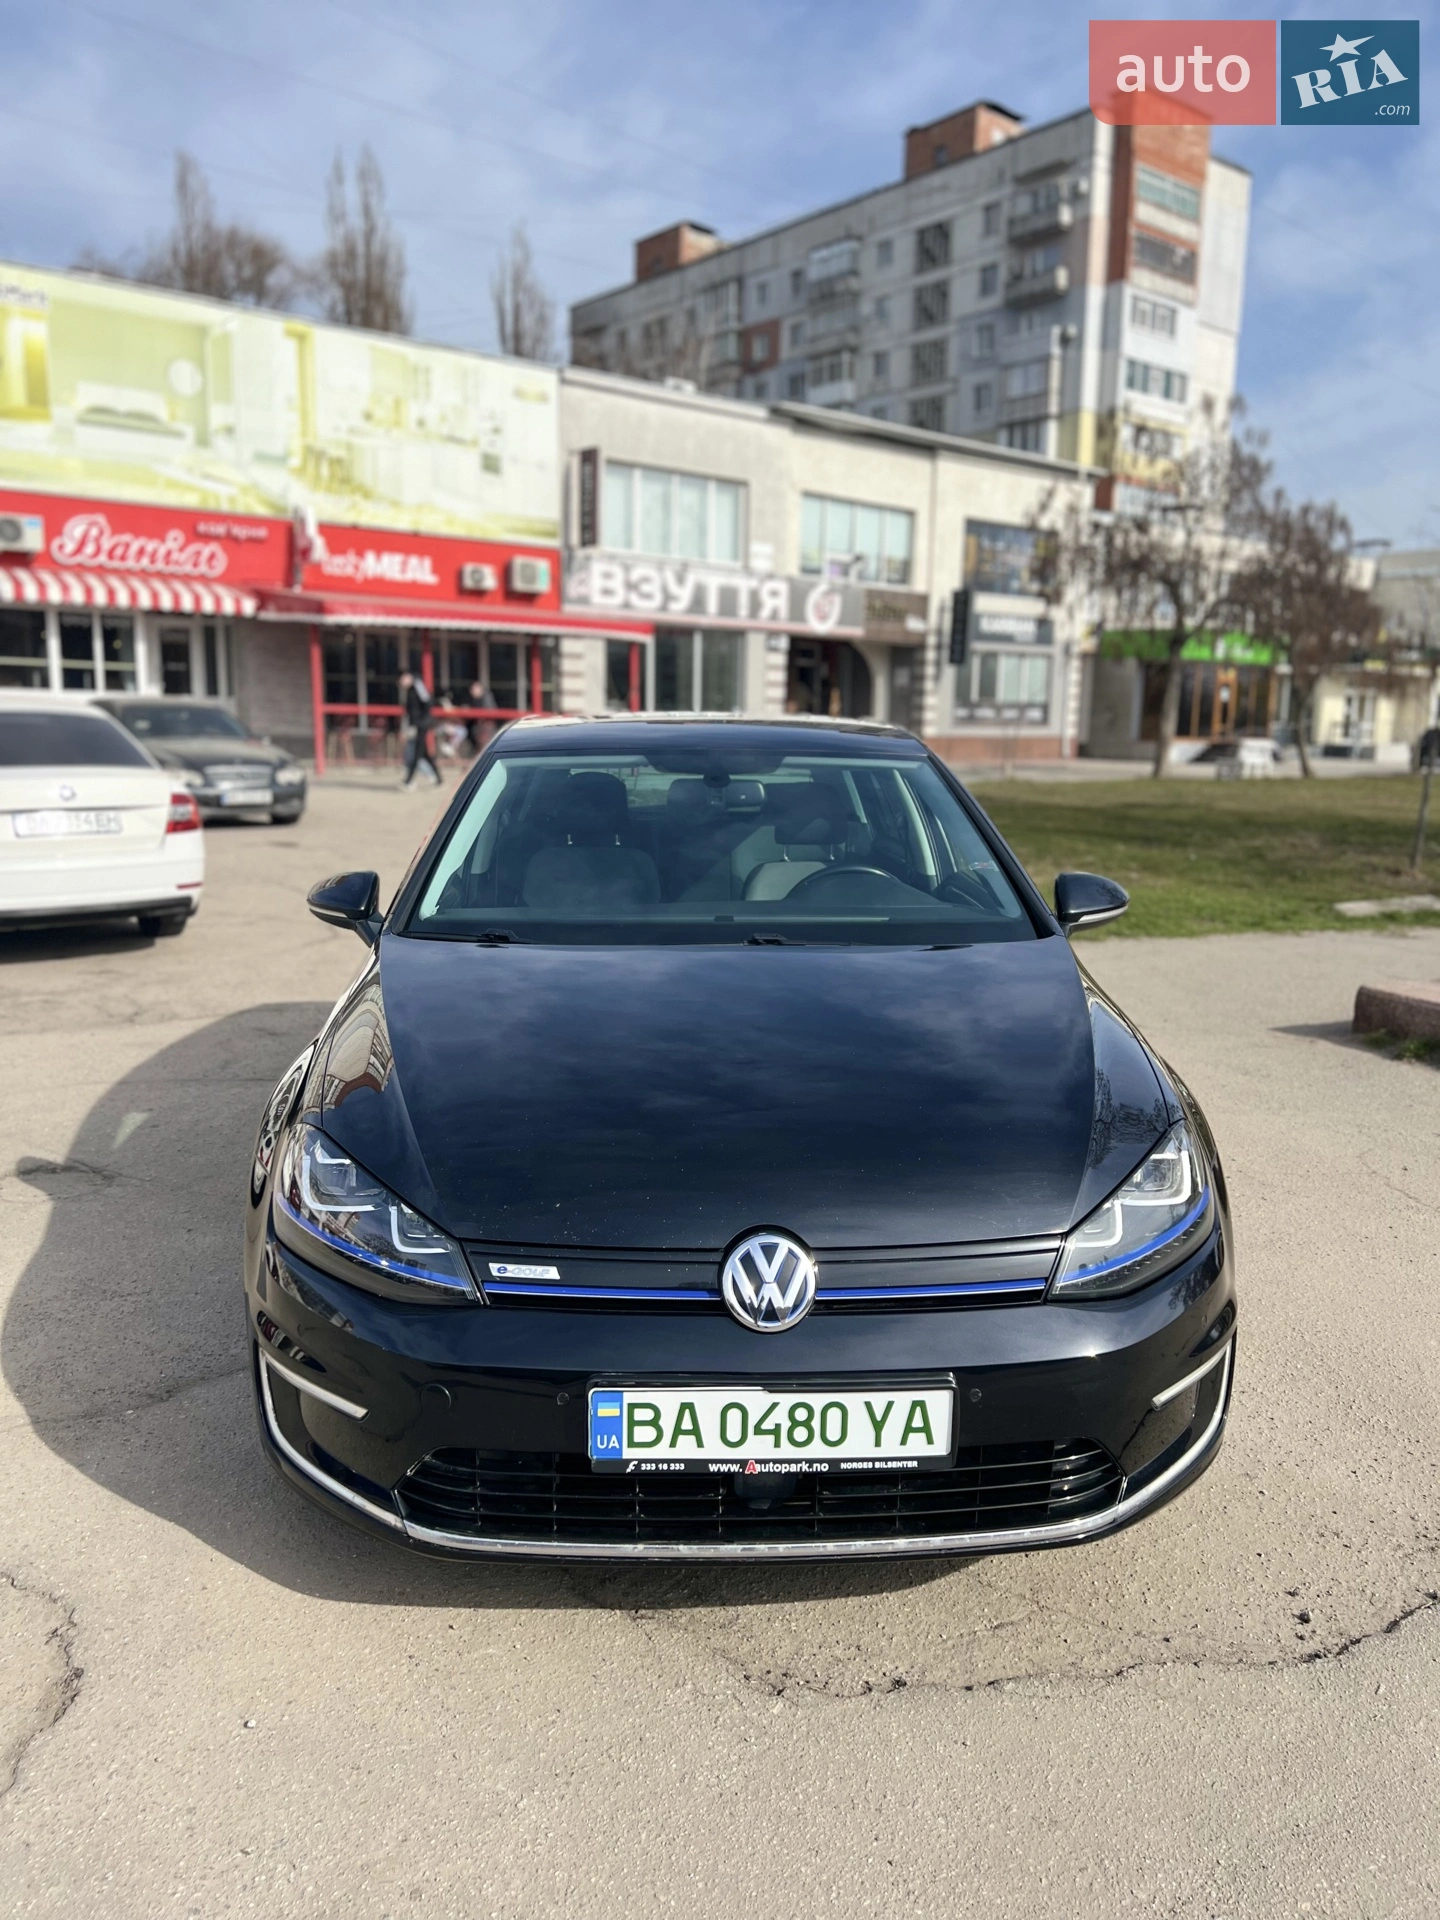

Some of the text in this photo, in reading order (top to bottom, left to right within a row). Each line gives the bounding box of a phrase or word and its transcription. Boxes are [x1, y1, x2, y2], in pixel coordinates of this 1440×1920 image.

[590, 560, 790, 621] ВЗУТТЯ
[627, 1400, 935, 1449] BA 0480 YA
[597, 1434, 620, 1450] UA
[640, 1463, 657, 1471] 333
[669, 1463, 686, 1471] 333
[840, 1461, 873, 1470] NORGES
[874, 1460, 919, 1469] BILSENTER
